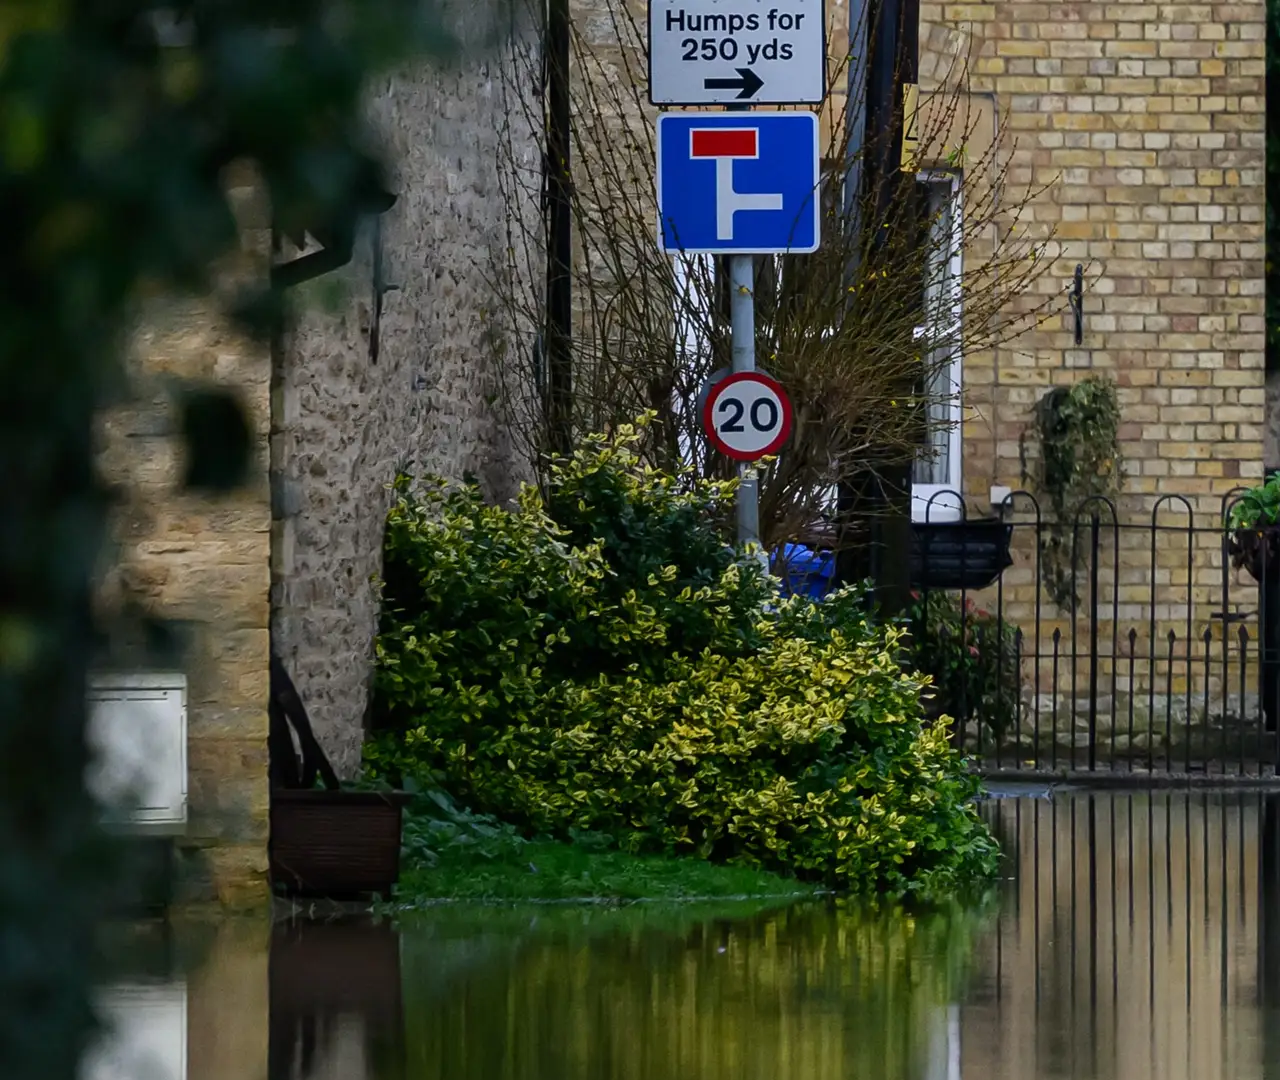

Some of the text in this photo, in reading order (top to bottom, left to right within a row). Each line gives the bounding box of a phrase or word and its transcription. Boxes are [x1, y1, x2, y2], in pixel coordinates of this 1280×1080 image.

[665, 8, 805, 35] Humps for
[681, 37, 794, 65] 250 yds
[718, 398, 779, 433] 20
